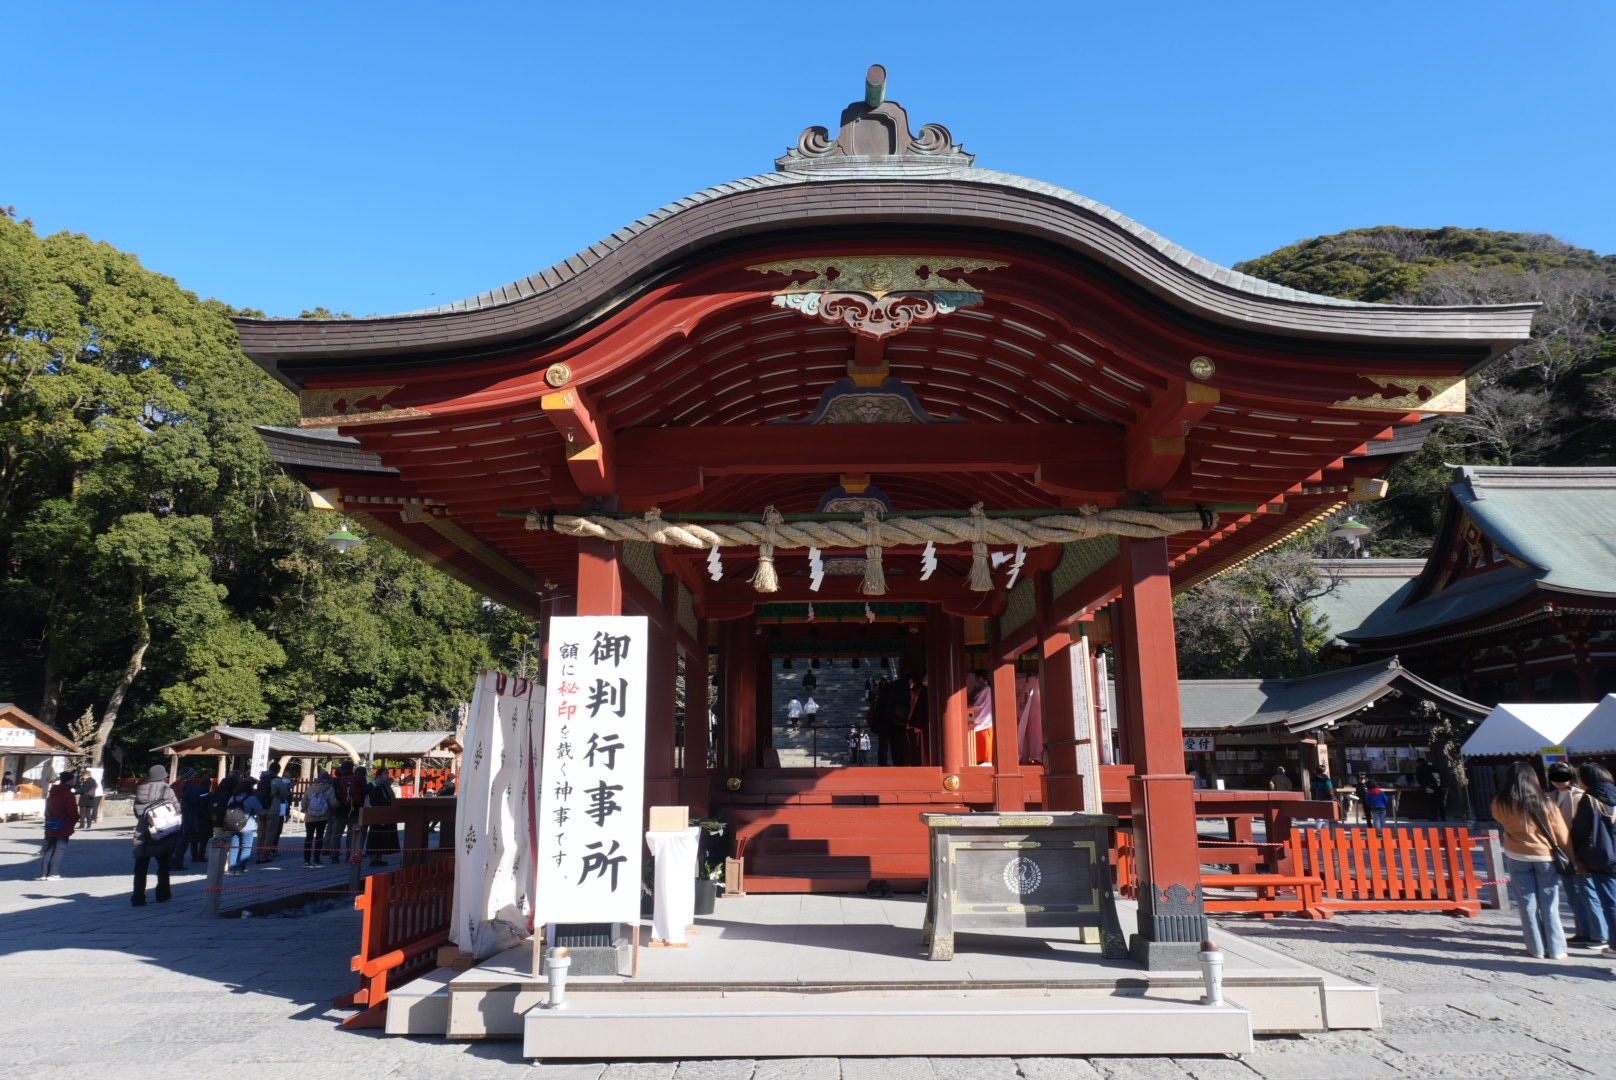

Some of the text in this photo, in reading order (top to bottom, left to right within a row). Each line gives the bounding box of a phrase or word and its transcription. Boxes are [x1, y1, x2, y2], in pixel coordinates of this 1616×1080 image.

[576, 630, 631, 893] 御判行事所
